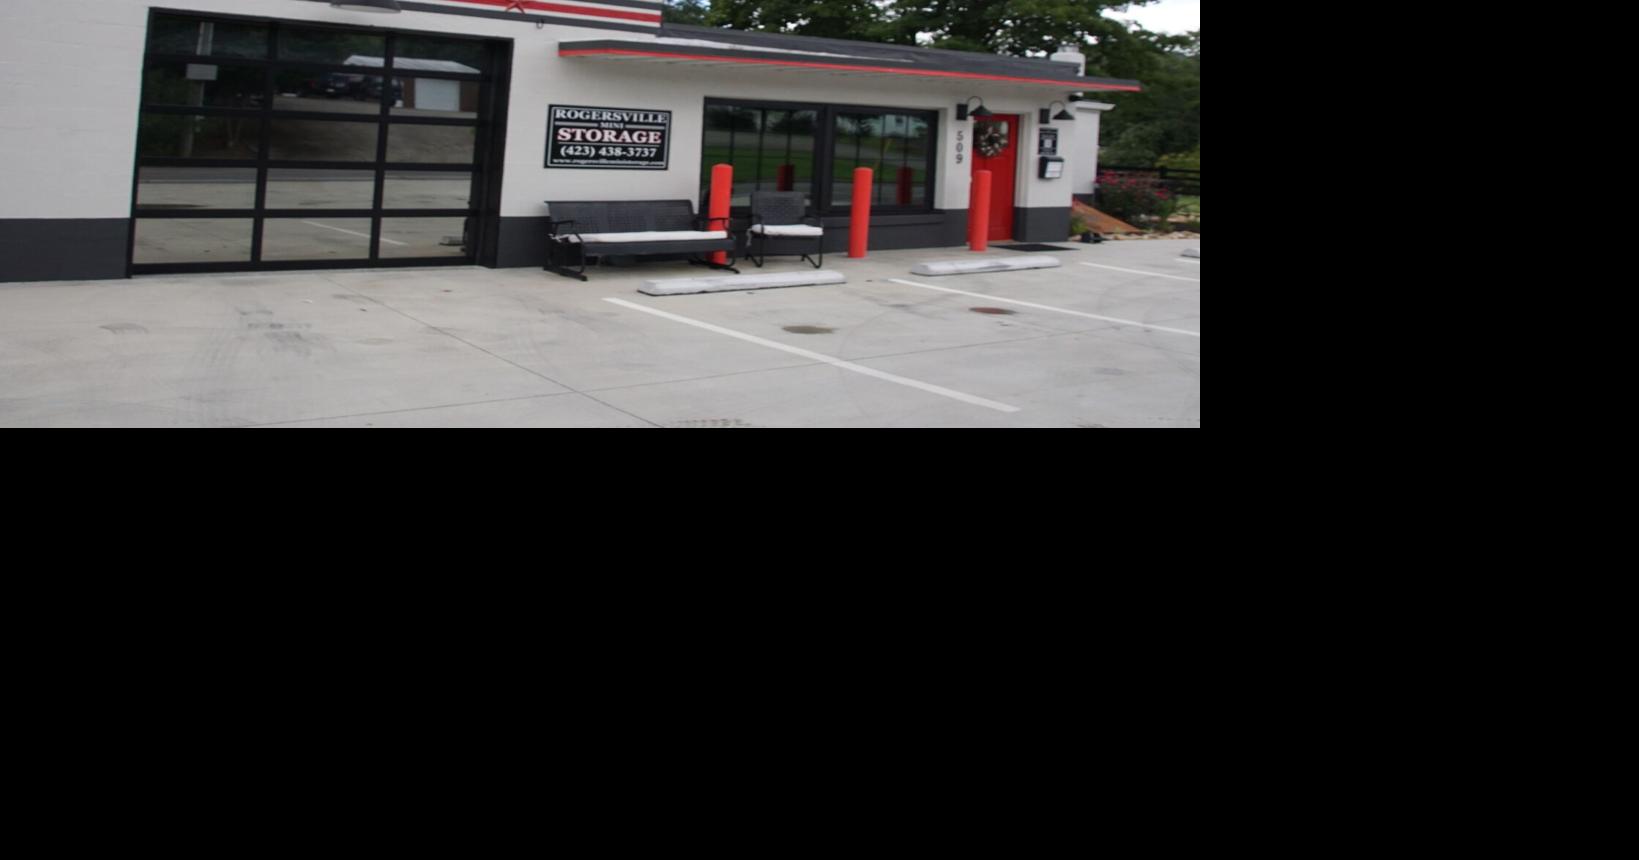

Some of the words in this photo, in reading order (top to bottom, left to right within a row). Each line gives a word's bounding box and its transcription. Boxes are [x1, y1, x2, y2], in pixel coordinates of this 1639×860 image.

[555, 109, 667, 123] ROGERSVILLE
[557, 128, 662, 144] STORAGE
[560, 146, 595, 157] (423)
[599, 147, 657, 157] 438-3737
[955, 130, 964, 164] 509
